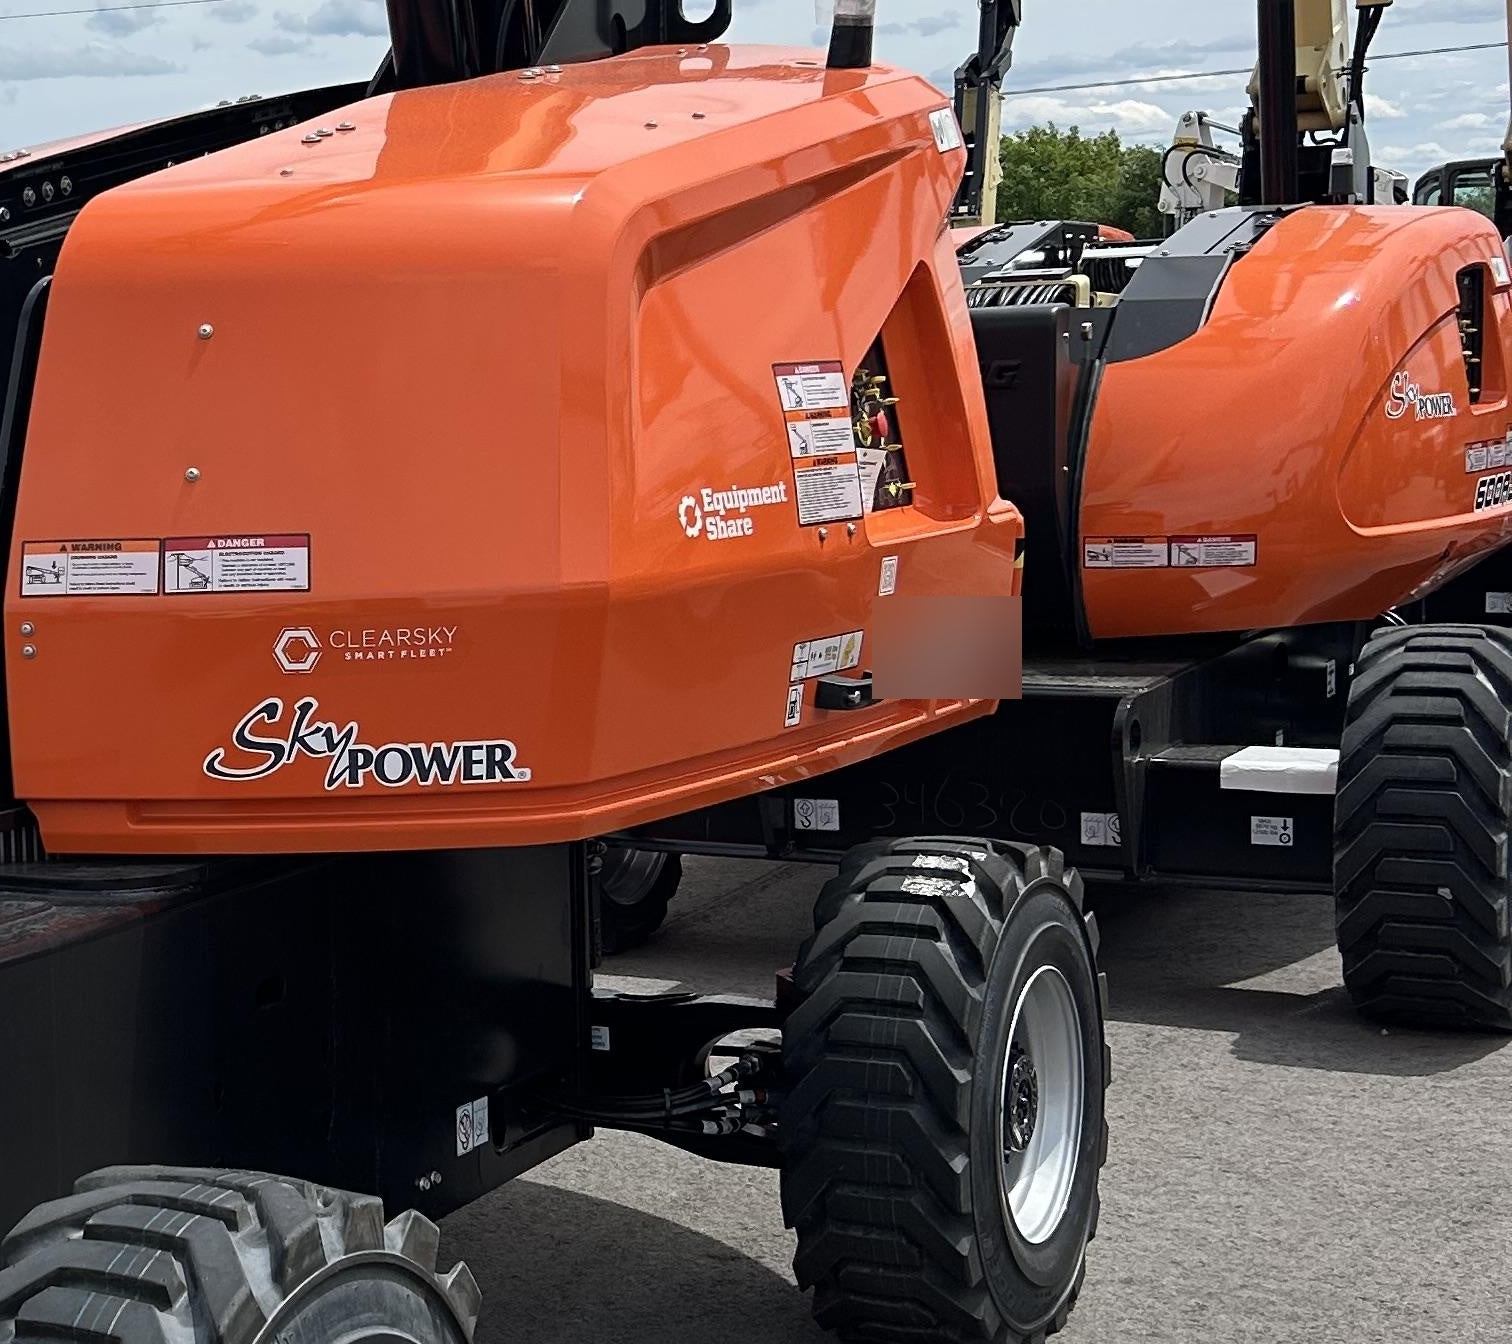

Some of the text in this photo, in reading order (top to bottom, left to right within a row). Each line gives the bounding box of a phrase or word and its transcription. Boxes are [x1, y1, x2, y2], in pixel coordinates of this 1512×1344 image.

[700, 481, 787, 514] Equipment
[705, 516, 753, 540] Share
[217, 538, 265, 548] DANGER
[329, 626, 457, 648] CLEARSKY
[344, 650, 395, 660] SMART
[206, 700, 515, 788] Sky POWER
